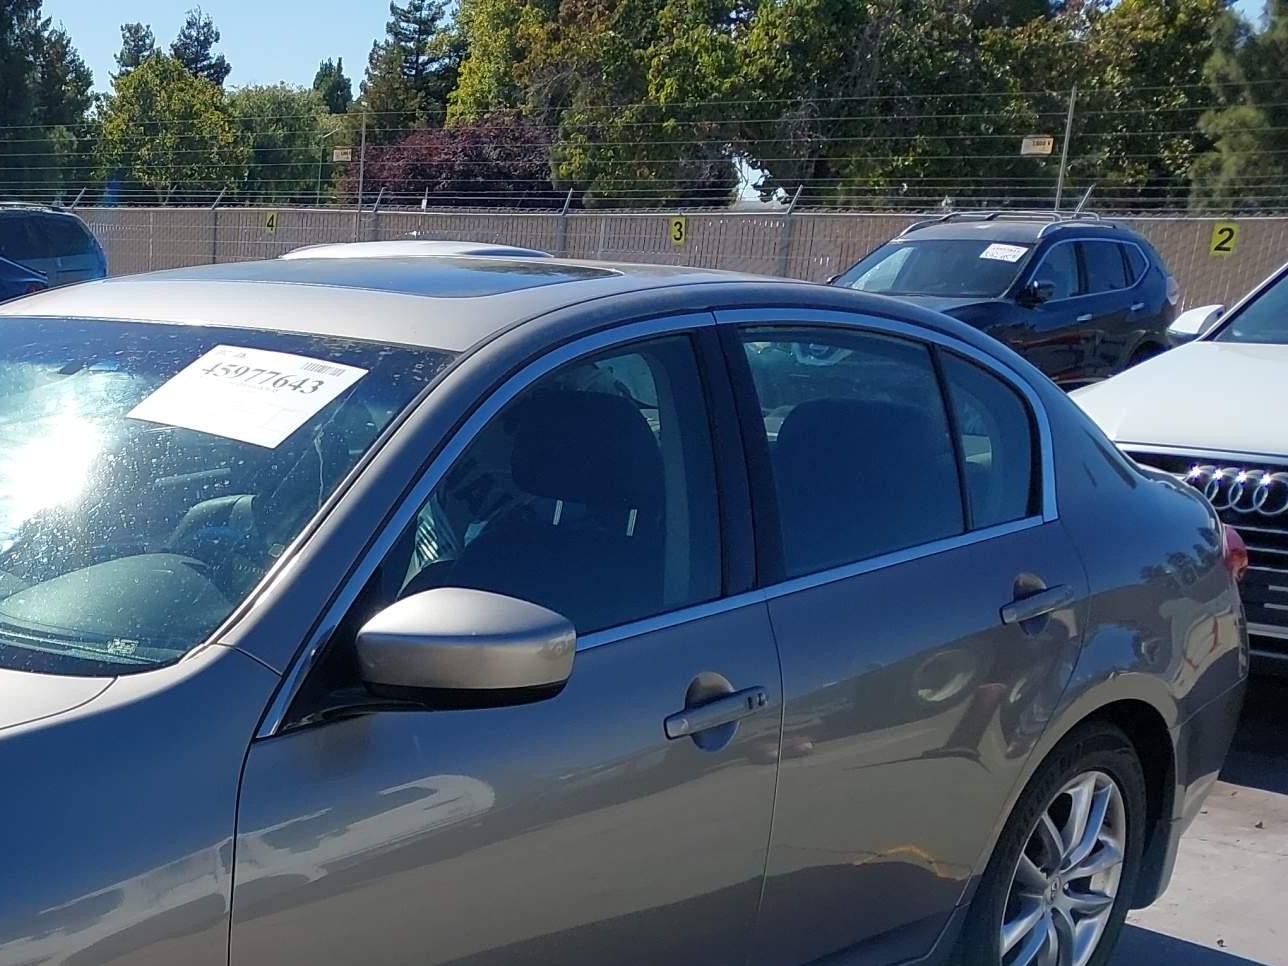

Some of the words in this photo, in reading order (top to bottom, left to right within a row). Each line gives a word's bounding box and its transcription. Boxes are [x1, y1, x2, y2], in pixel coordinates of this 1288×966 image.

[266, 214, 275, 231] 4
[673, 221, 683, 241] 3
[1214, 227, 1234, 251] 2
[201, 362, 325, 394] 45977643
